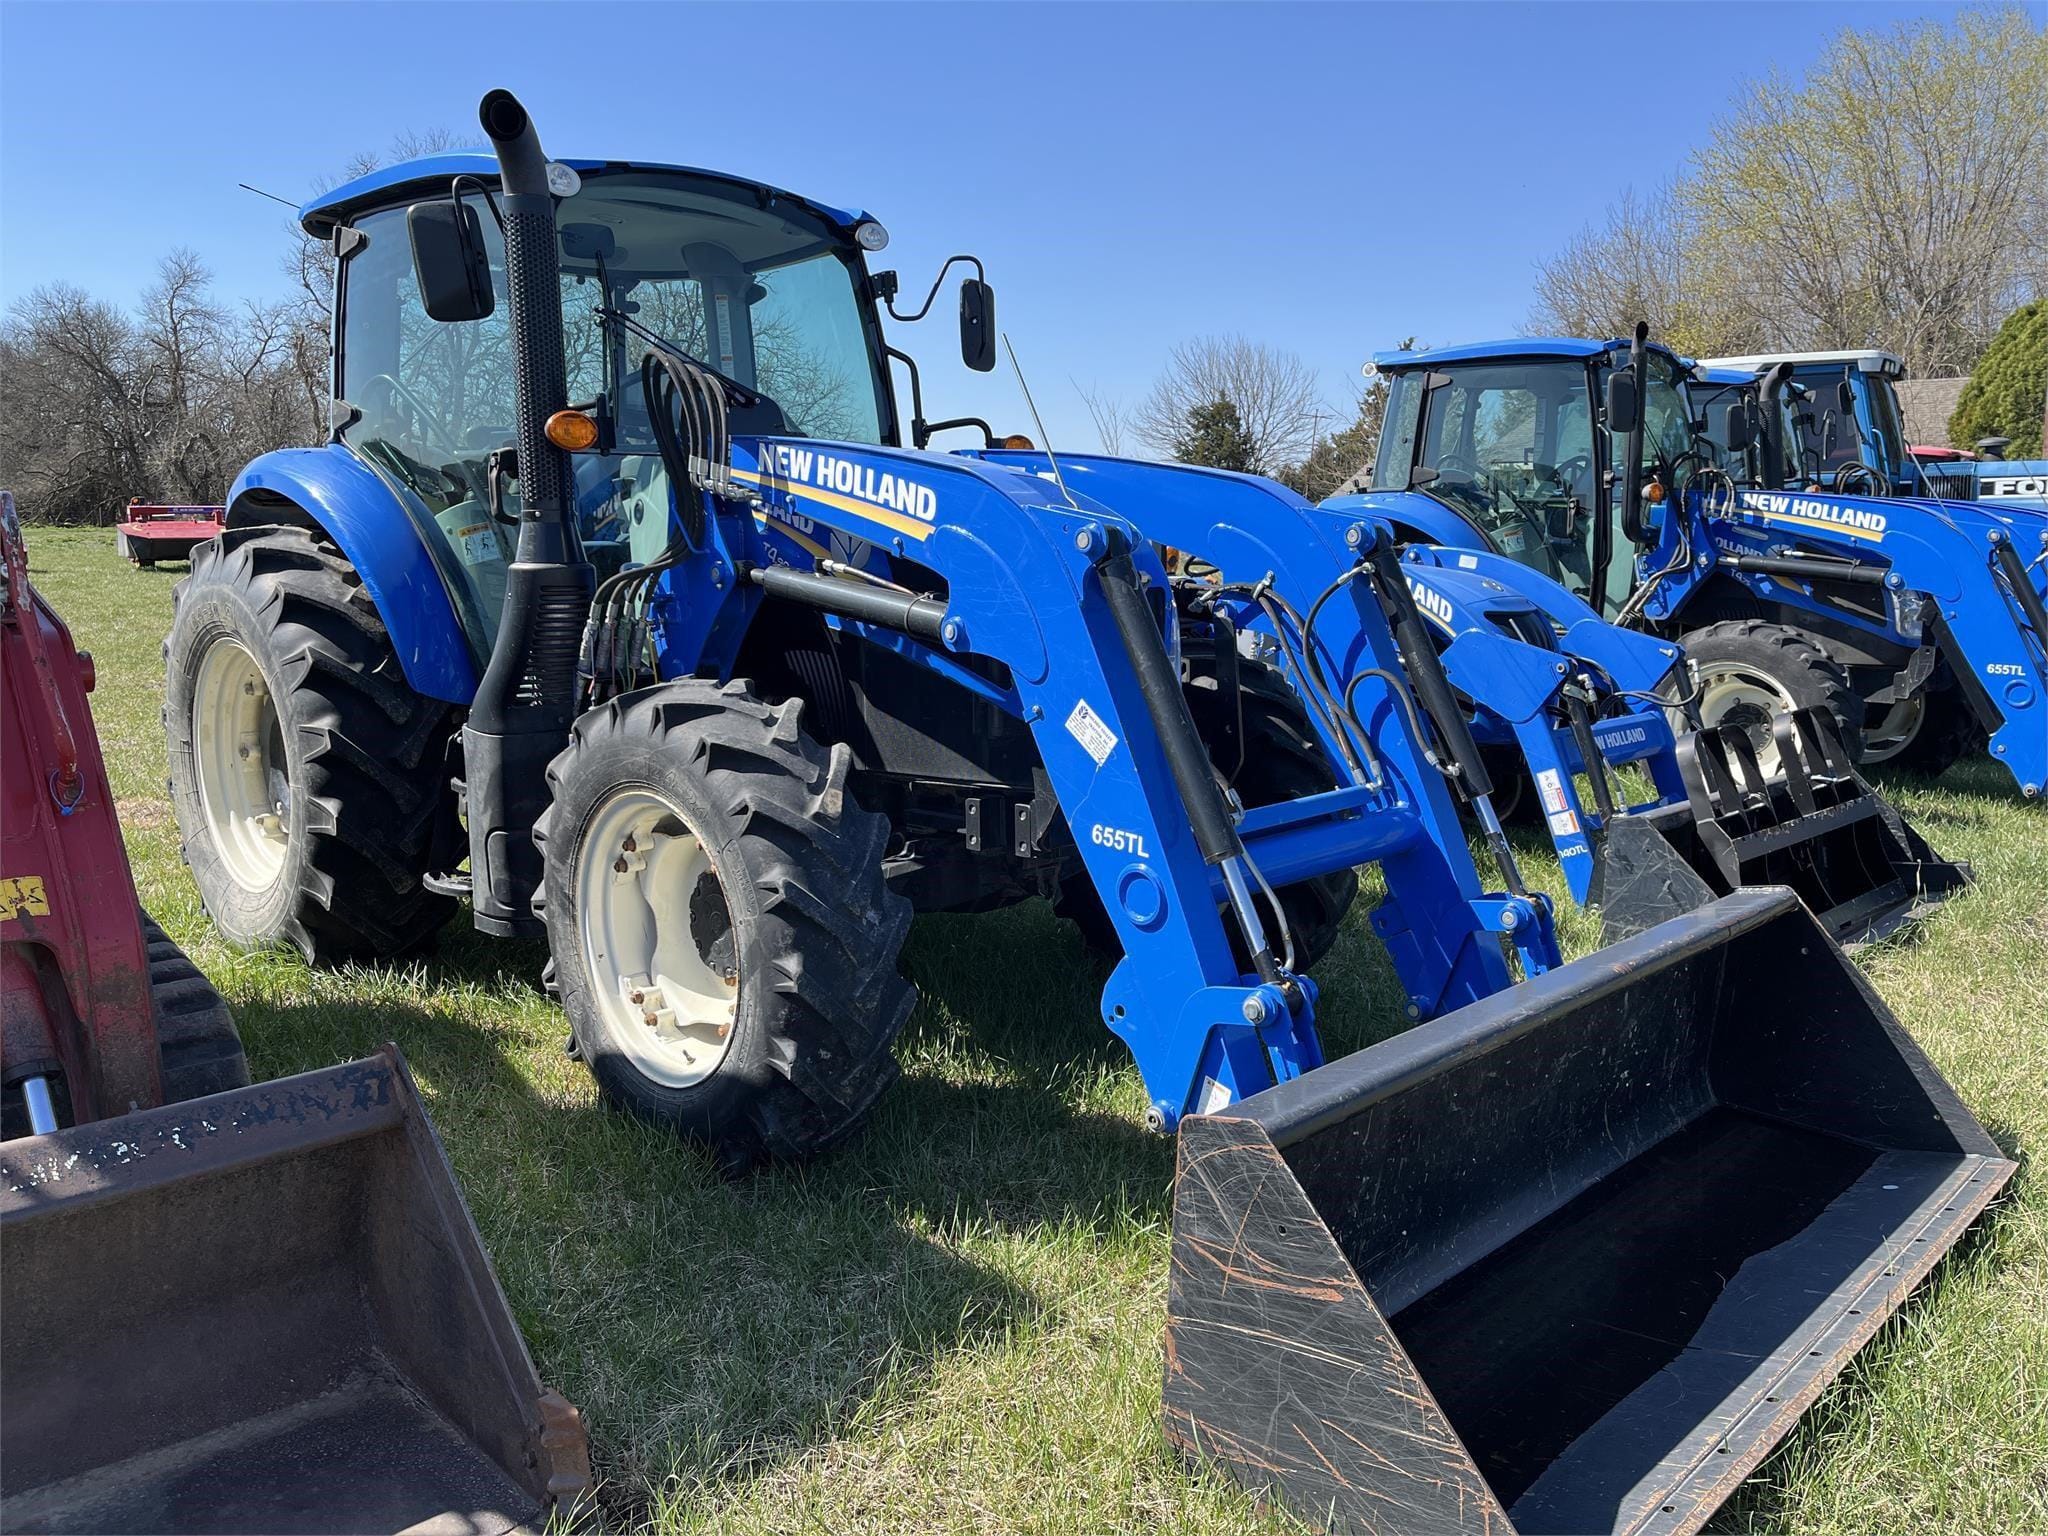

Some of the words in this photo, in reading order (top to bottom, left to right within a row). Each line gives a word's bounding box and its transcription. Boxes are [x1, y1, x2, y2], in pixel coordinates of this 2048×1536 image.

[758, 442, 813, 482] NEW
[816, 455, 936, 521] HOLLAND
[1994, 480, 2048, 495] FO
[1743, 493, 1791, 513] NEW
[1791, 499, 1886, 532] HOLLAND
[1987, 663, 2026, 676] 655TL
[1604, 727, 1646, 748] HOLLAND
[1091, 823, 1149, 858] 655TL
